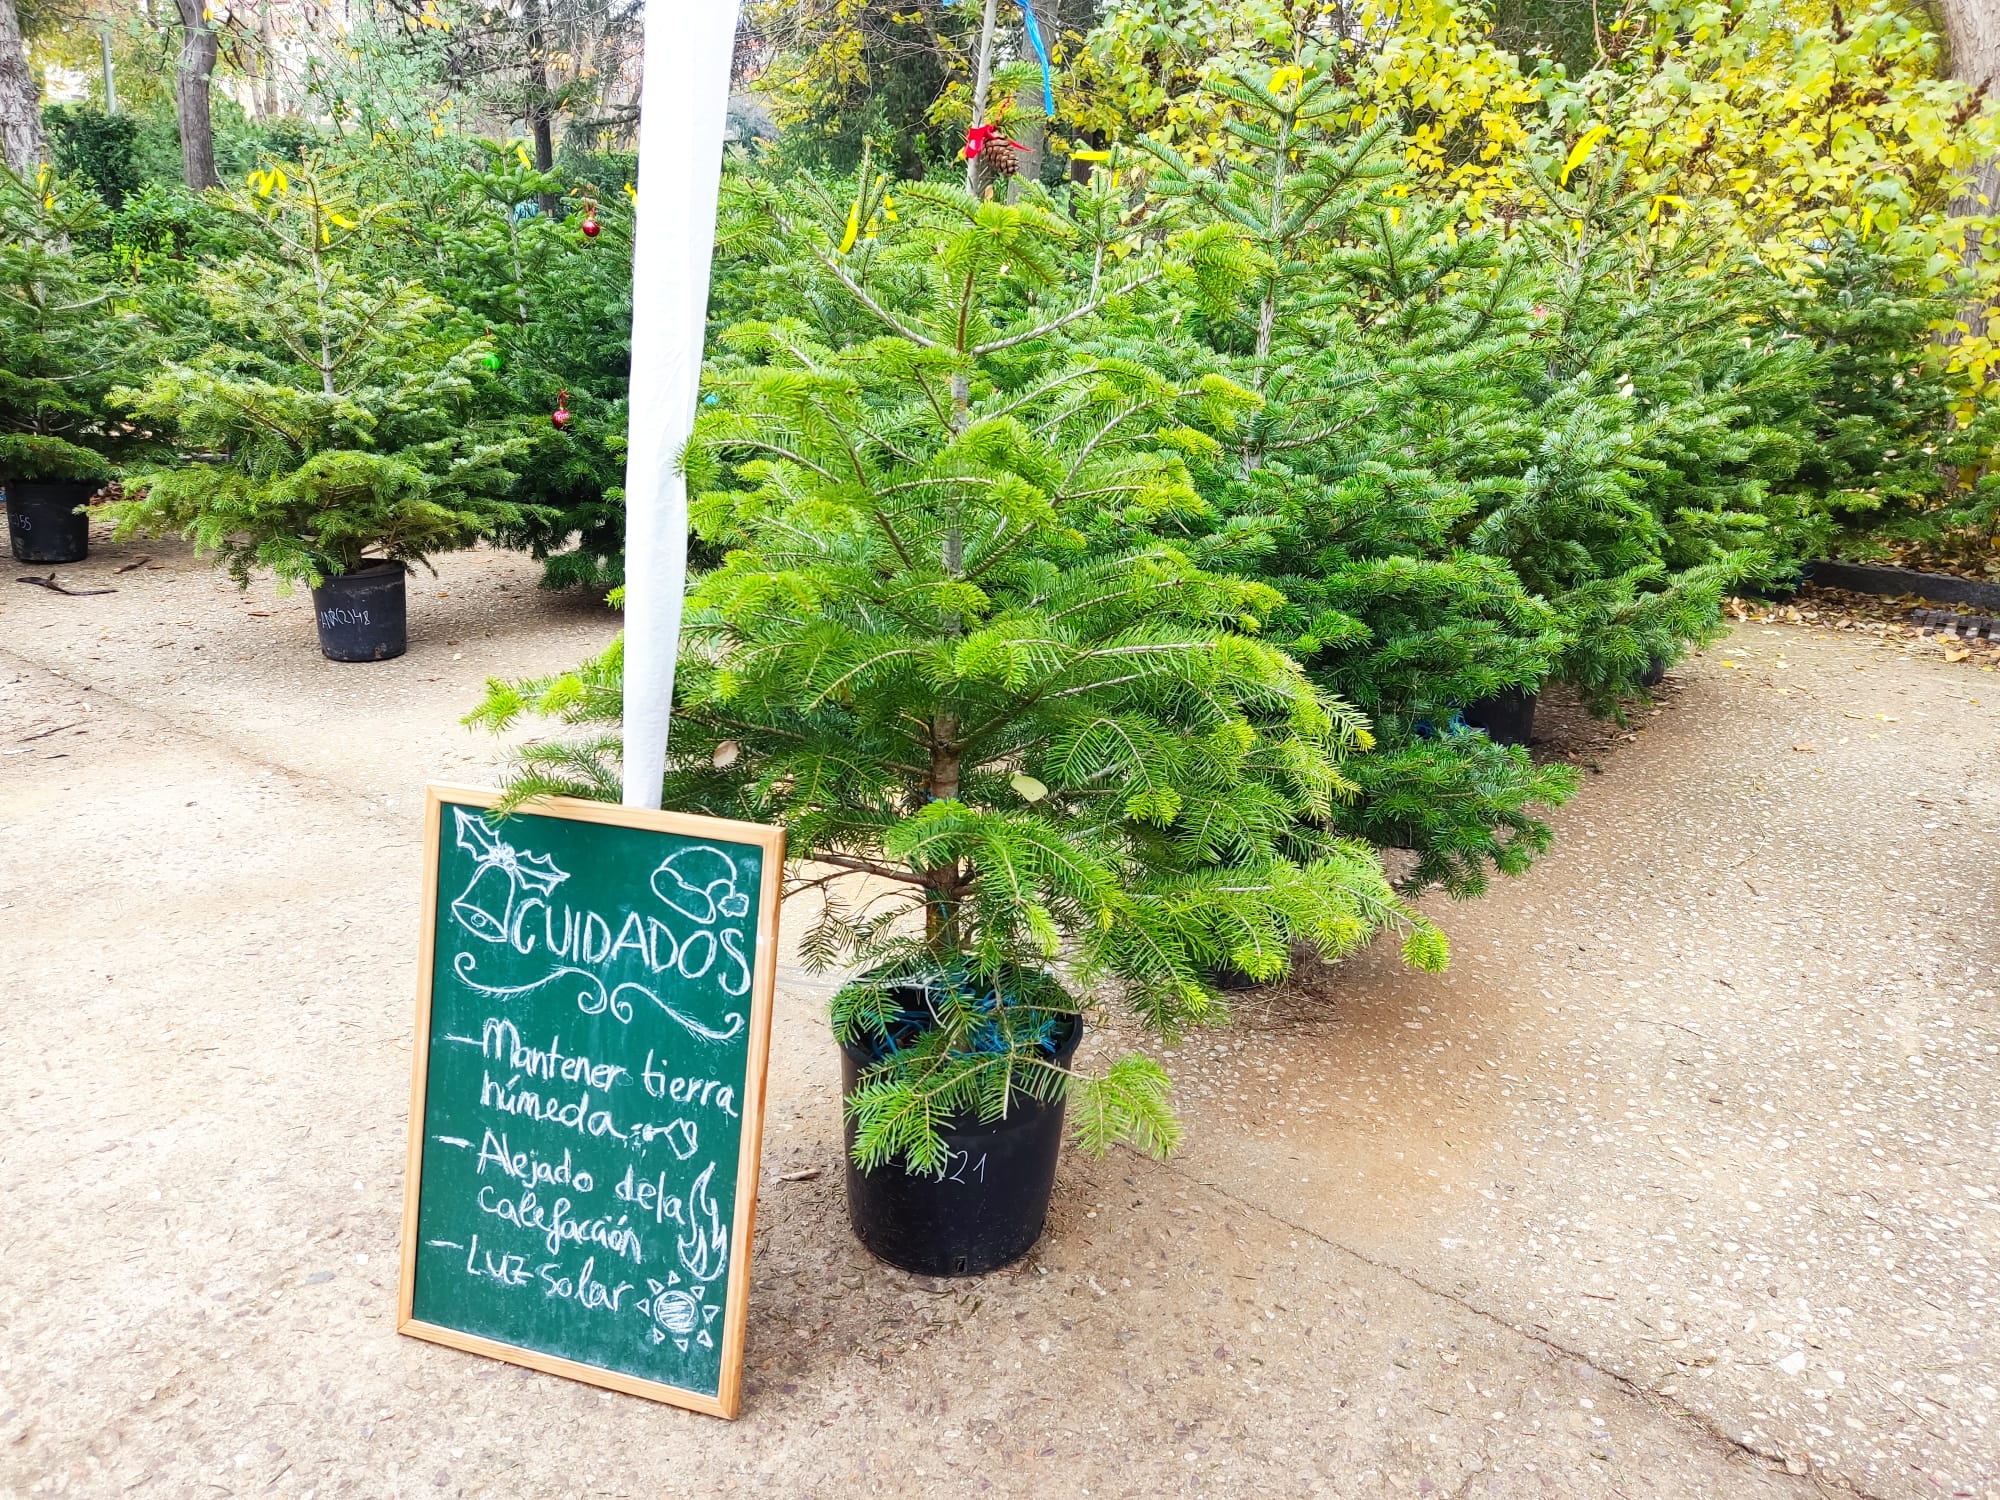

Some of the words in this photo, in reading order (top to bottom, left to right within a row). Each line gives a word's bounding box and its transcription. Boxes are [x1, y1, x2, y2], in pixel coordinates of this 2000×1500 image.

[511, 898, 751, 996] CUIDADOS
[479, 1069, 629, 1140] húmeda
[482, 1017, 628, 1093] Mantener
[641, 1048, 738, 1118] tierra
[476, 1128, 594, 1192] Alejado
